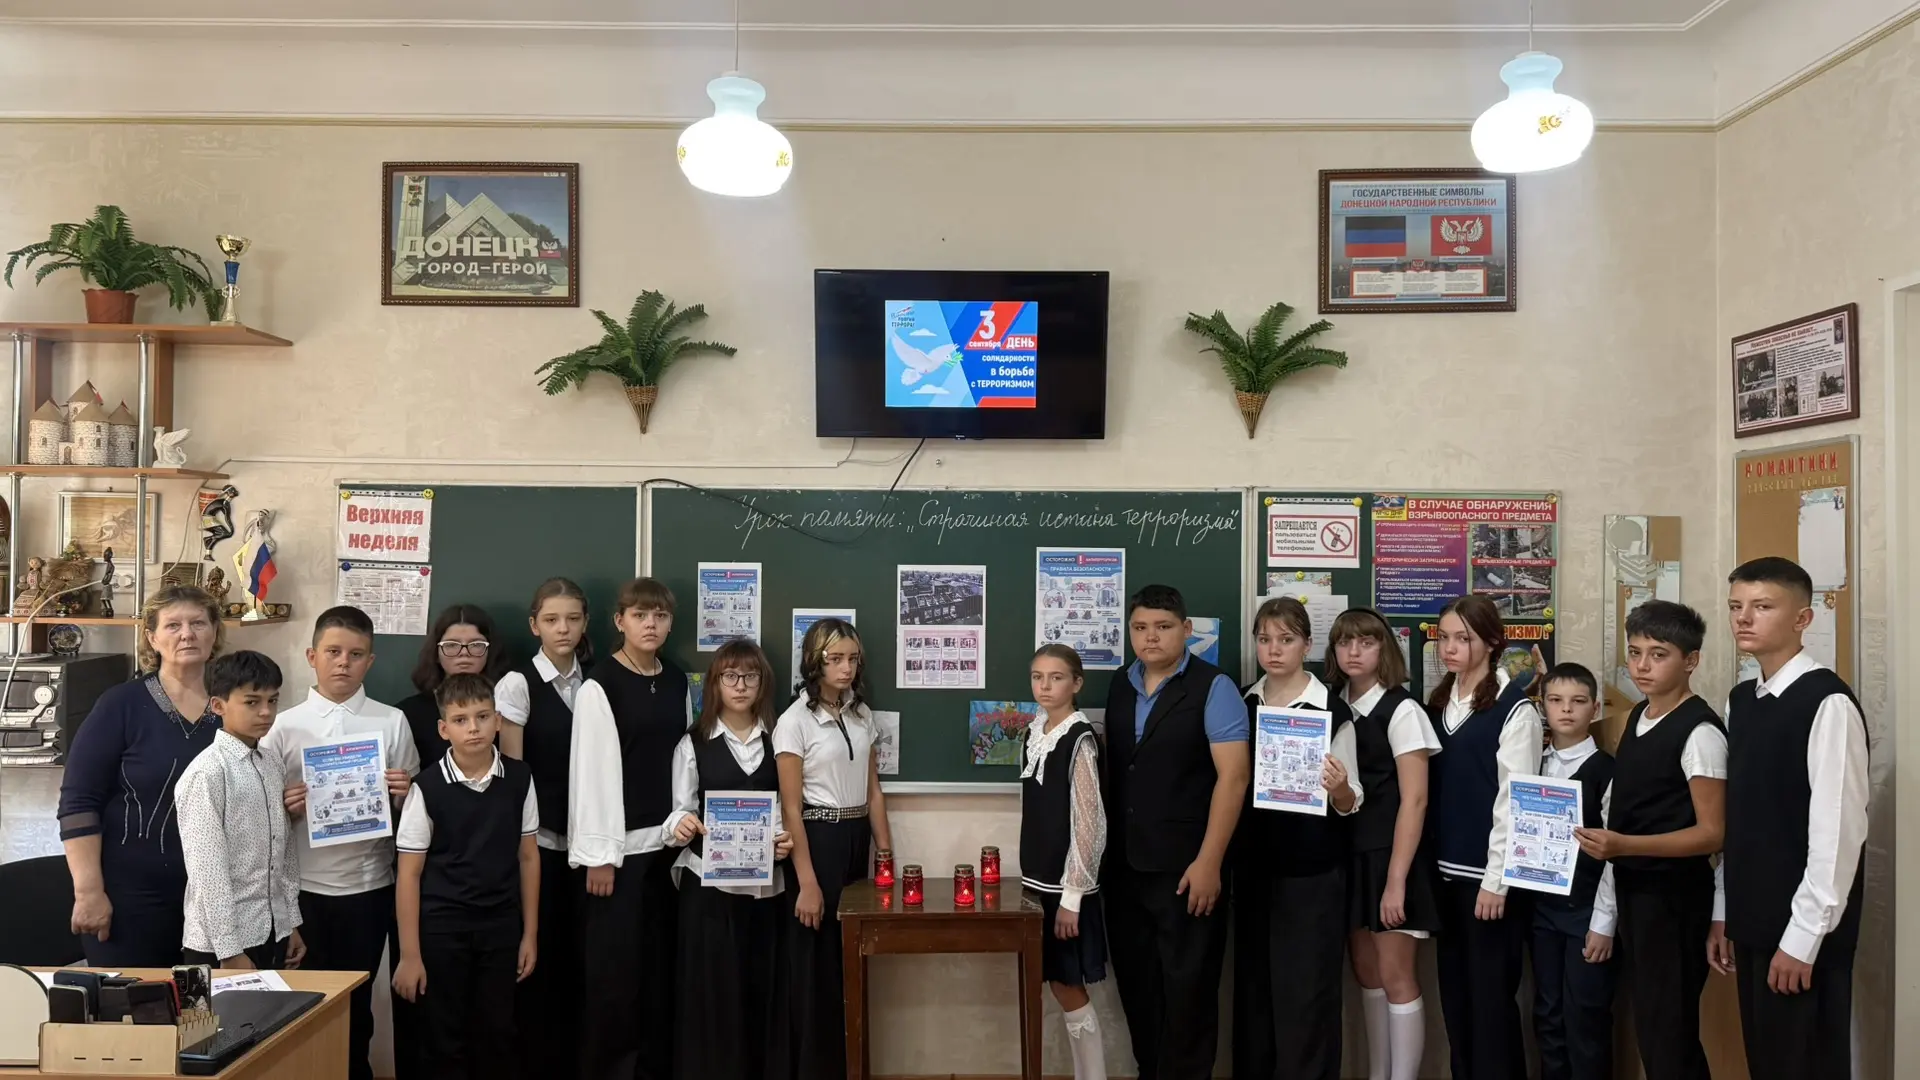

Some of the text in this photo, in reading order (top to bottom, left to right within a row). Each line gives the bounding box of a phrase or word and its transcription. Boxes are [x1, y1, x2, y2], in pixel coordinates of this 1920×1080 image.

[1352, 187, 1484, 198] ГОСУДАРСТВЕННЫЕ СИМВОЛЫ
[1340, 198, 1497, 209] ДОНЕЦКОЙ НАРОДНОЙ РЕСПУБЛИКИ
[400, 235, 539, 259] ДОНЕЦК
[979, 310, 996, 340] 3
[968, 336, 1035, 350] сентября ДЕНЬ
[999, 366, 1034, 378] борьбе
[977, 380, 1034, 388] ТЕРРОРИЗМОМ
[1745, 452, 1838, 478] РОМАНТИКИ
[1408, 500, 1552, 510] В СЛУЧАЕ ОБНАРУЖЕНИЯ
[346, 504, 424, 525] Верхняя
[1408, 512, 1499, 520] ВЗРЫВООПАСНОГО
[1502, 512, 1552, 521] ПРЕДМЕТА
[733, 496, 793, 550] Урок
[799, 509, 905, 529] памяти:
[1038, 509, 1117, 529] истина
[1274, 520, 1318, 530] ЗАПРЕЩАЕТСЯ
[348, 533, 419, 552] неделя
